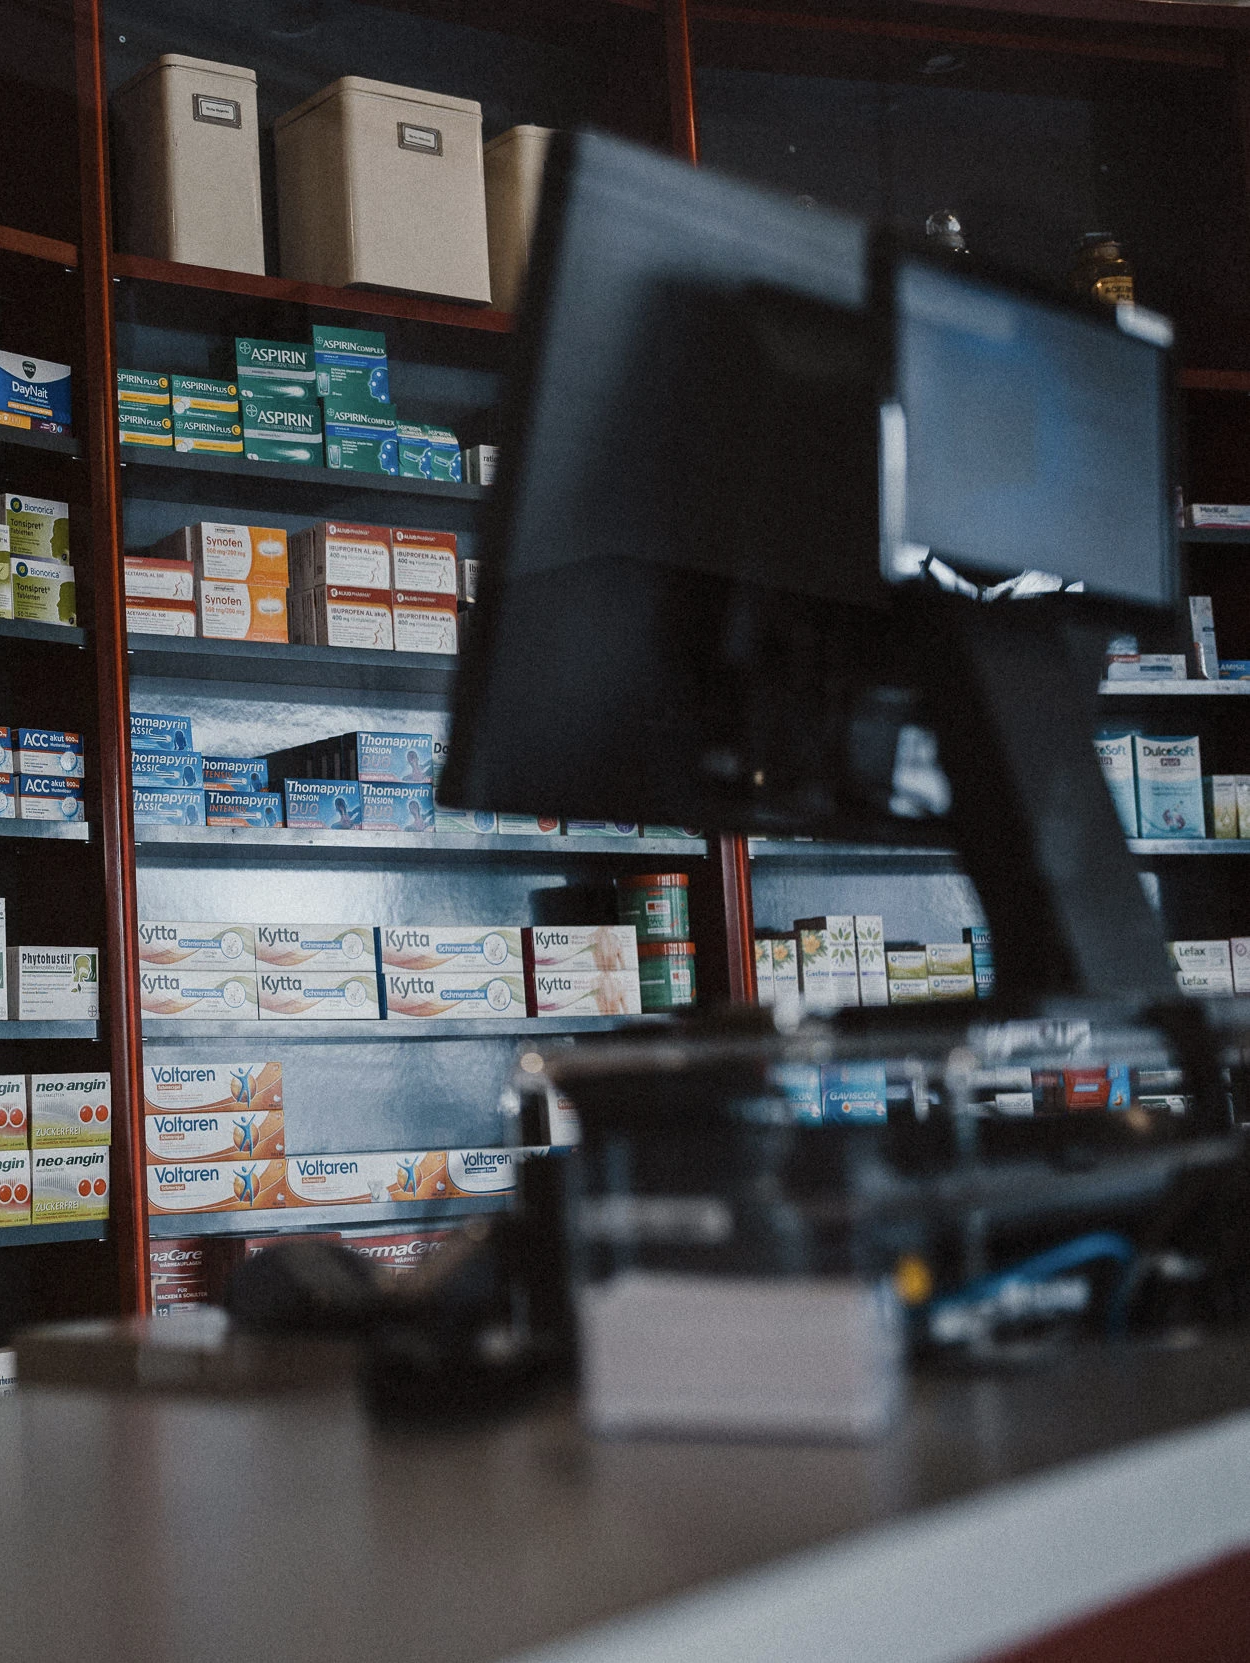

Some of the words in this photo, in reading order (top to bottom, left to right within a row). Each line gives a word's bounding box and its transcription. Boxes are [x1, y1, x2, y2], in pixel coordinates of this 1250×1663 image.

[322, 340, 358, 352] ASPIRIN
[357, 345, 385, 354] COMPLEX
[251, 348, 306, 365] ASPIRIN
[12, 381, 48, 399] DayNait
[181, 380, 213, 391] ASPIRIN
[212, 386, 227, 394] PLUS
[257, 411, 312, 428] ASPIRIN
[334, 412, 368, 423] ASPIRIN
[368, 417, 395, 426] COMPLEX
[183, 422, 216, 432] ASPIRIN
[24, 502, 54, 516] Bionorica
[11, 518, 41, 531] Tonsipret
[206, 536, 243, 549] Synofen
[329, 545, 363, 555] IBUPROFEN
[397, 551, 429, 560] IBUPROFEN
[30, 567, 60, 580] Bionorica
[17, 583, 47, 595] Tonsipret
[205, 594, 242, 608] Synofen
[331, 607, 364, 616] IBUPROFEN
[397, 612, 429, 621] IBUPROFEN
[23, 733, 48, 747] ACC
[50, 734, 64, 742] akut
[360, 733, 428, 749] Thomapyrin
[361, 746, 392, 754] TENSION
[1143, 745, 1195, 757] DulcoSoft
[361, 755, 391, 768] DUO
[1162, 758, 1180, 766] PLUS
[25, 779, 49, 793] ACC
[51, 779, 65, 788] akut
[287, 780, 355, 796] Thomapyrin
[361, 783, 429, 799] Thomapyrin
[209, 792, 278, 808] Thomapyrin
[289, 794, 320, 802] TENSION
[363, 797, 393, 805] TENSION
[289, 802, 319, 815] DUO
[363, 806, 393, 818] DUO
[259, 927, 299, 947] Kytta
[385, 930, 429, 953] Kytta
[535, 931, 569, 951] Kytta
[180, 941, 220, 949] Schmerzsalbe
[302, 941, 341, 949] Schmerzsalbe
[437, 944, 482, 953] Schmerzsalbe
[1179, 946, 1206, 957] Lefax
[22, 953, 70, 966] Phytohustil
[261, 976, 302, 995] Kytta
[537, 977, 571, 995] Kytta
[1182, 976, 1209, 986] Lefax
[182, 990, 223, 998] Schmerzsalbe
[305, 989, 344, 997] Schmerzsalbe
[390, 976, 434, 1000] Kytta
[442, 990, 485, 999] Schmerzsalbe
[151, 1066, 216, 1084] Voltaren
[830, 1090, 877, 1101] GAVISCON
[154, 1115, 218, 1133] Voltaren
[36, 1127, 81, 1137] ZUCKERFREI
[461, 1152, 512, 1167] Voltaren
[298, 1159, 358, 1176] Voltaren
[154, 1166, 219, 1183] Voltaren
[35, 1202, 80, 1213] ZUCKERFREI
[158, 1308, 168, 1317] 12
